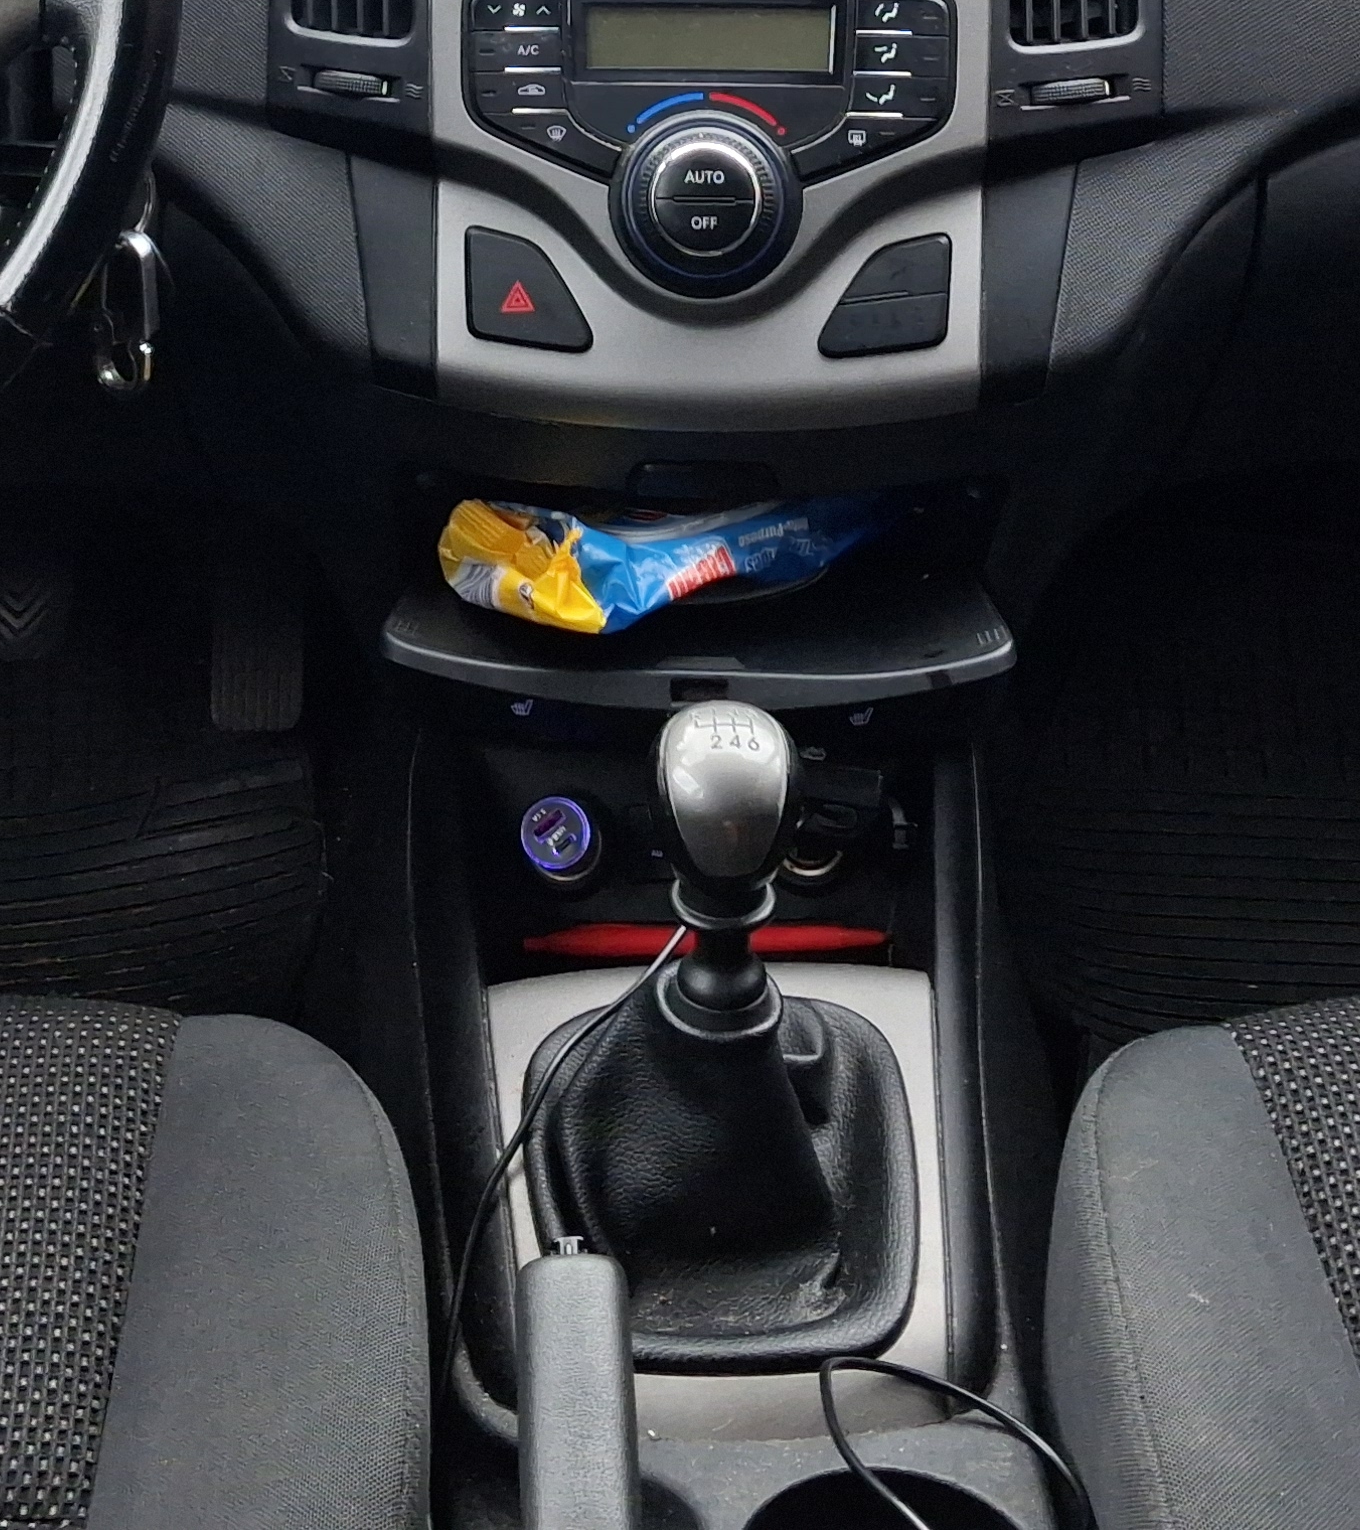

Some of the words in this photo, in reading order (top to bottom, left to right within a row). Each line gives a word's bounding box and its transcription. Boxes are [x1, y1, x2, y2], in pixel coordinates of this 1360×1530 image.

[517, 44, 540, 57] A/C
[683, 169, 725, 185] AUTO
[690, 215, 718, 230] OFF
[710, 734, 723, 750] 2
[729, 734, 742, 749] 4
[747, 736, 760, 751] 6
